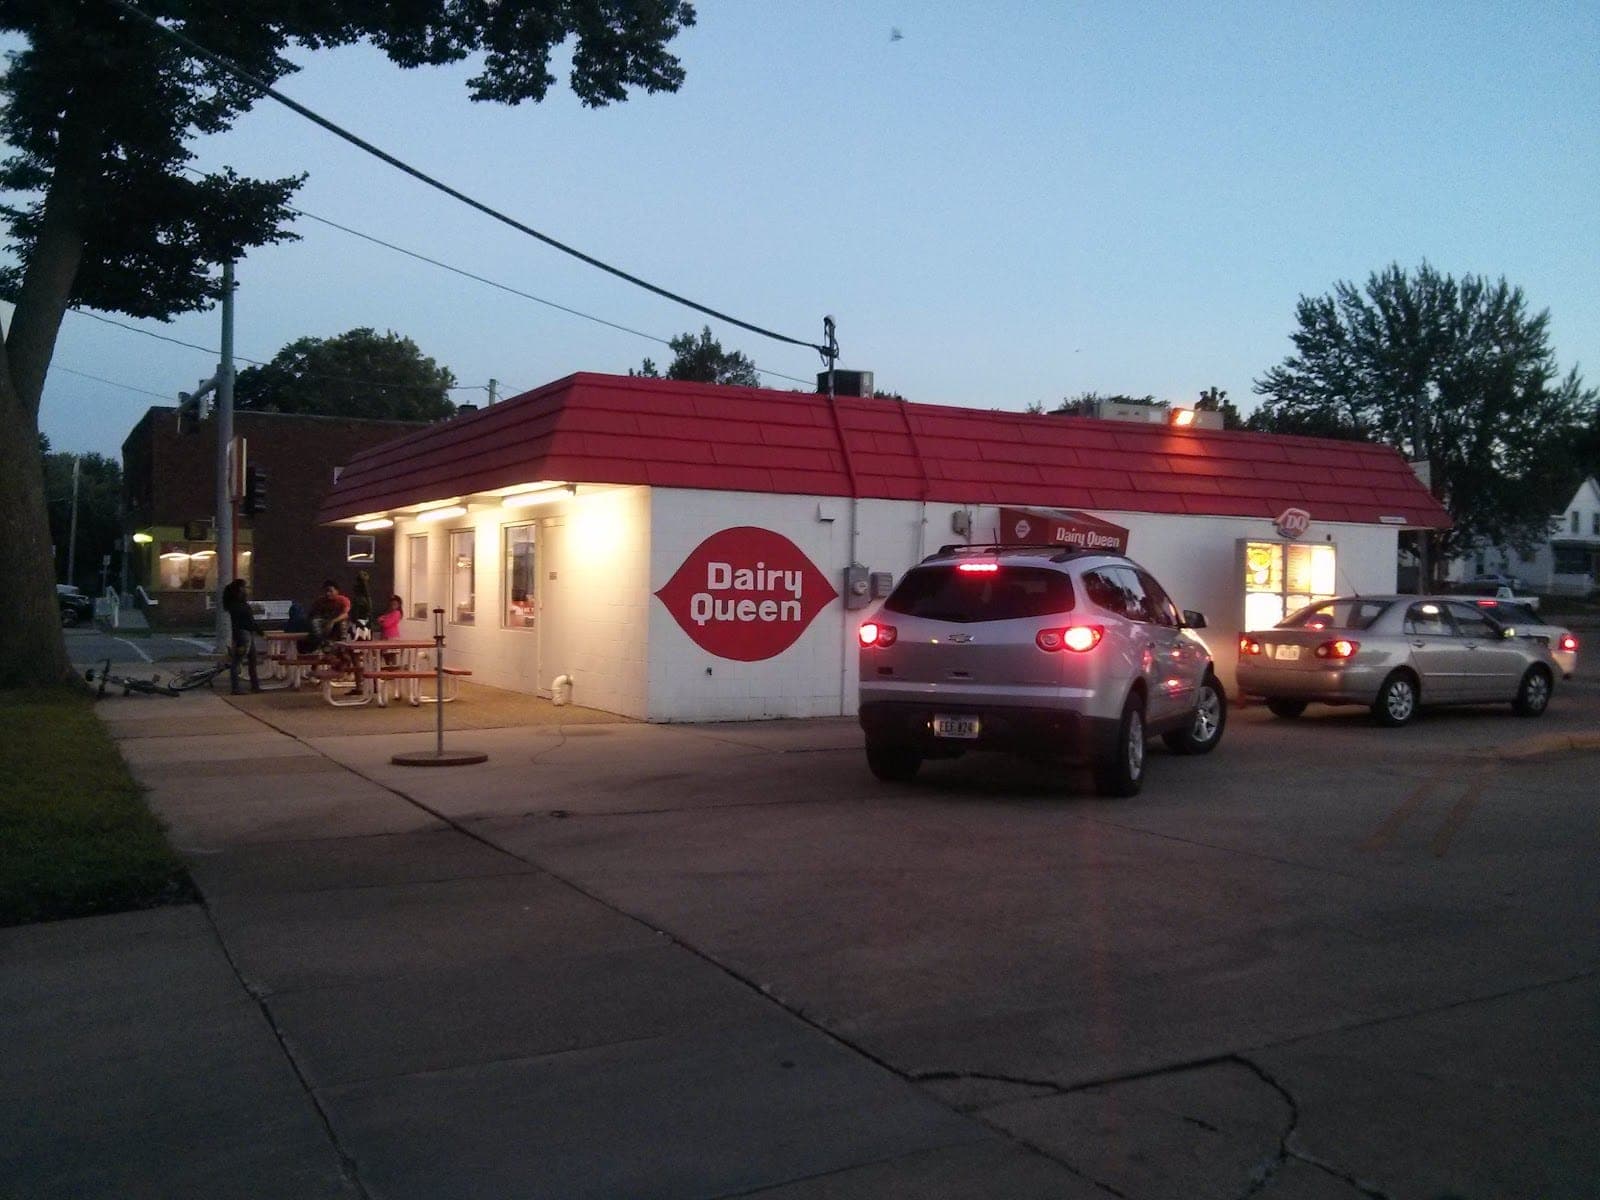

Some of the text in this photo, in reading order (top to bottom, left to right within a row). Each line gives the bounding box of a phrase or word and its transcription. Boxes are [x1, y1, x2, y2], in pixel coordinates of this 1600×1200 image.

[1286, 514, 1304, 530] DQ
[1056, 527, 1120, 547] Dairy Queen
[707, 561, 803, 599] Dairy
[690, 592, 801, 626] Queen
